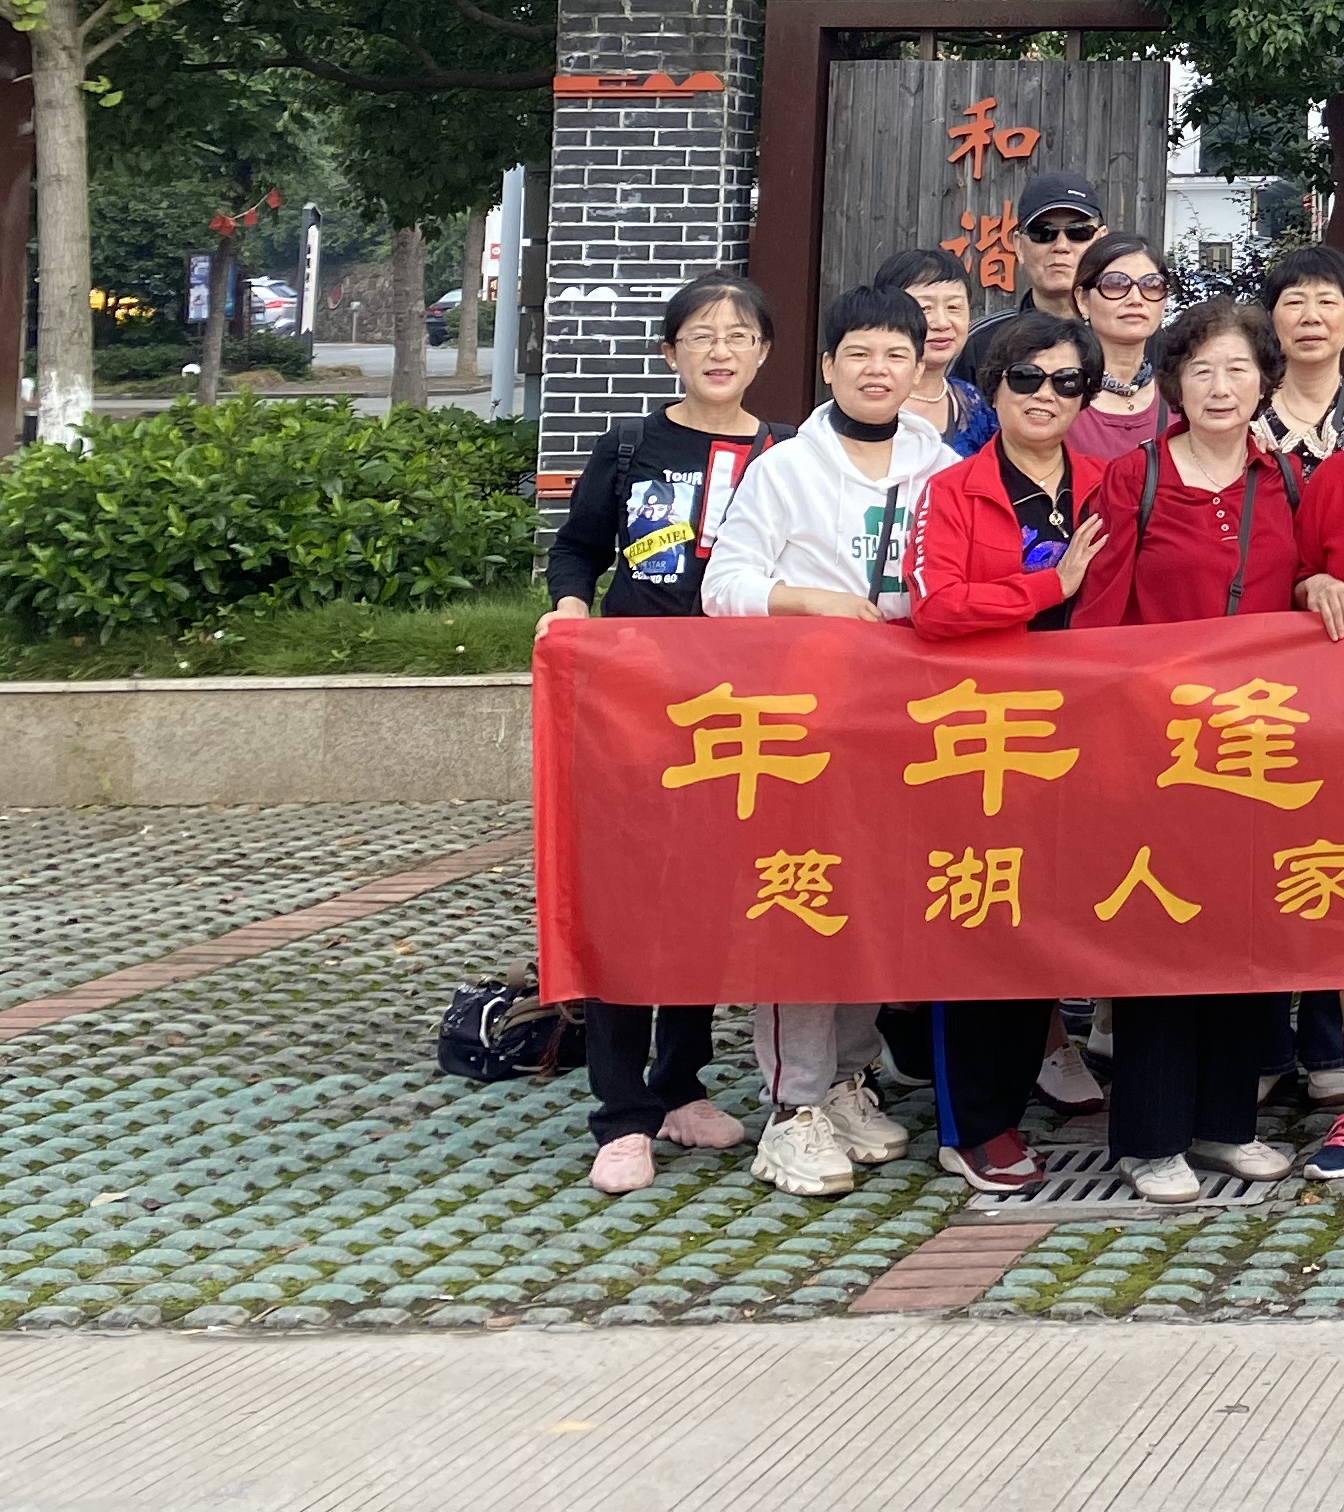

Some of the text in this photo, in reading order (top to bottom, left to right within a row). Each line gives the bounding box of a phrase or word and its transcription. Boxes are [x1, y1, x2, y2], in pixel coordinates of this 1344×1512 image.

[940, 97, 1041, 292] 和谐
[662, 469, 703, 486] TOUR
[629, 529, 686, 558] HELP ME!
